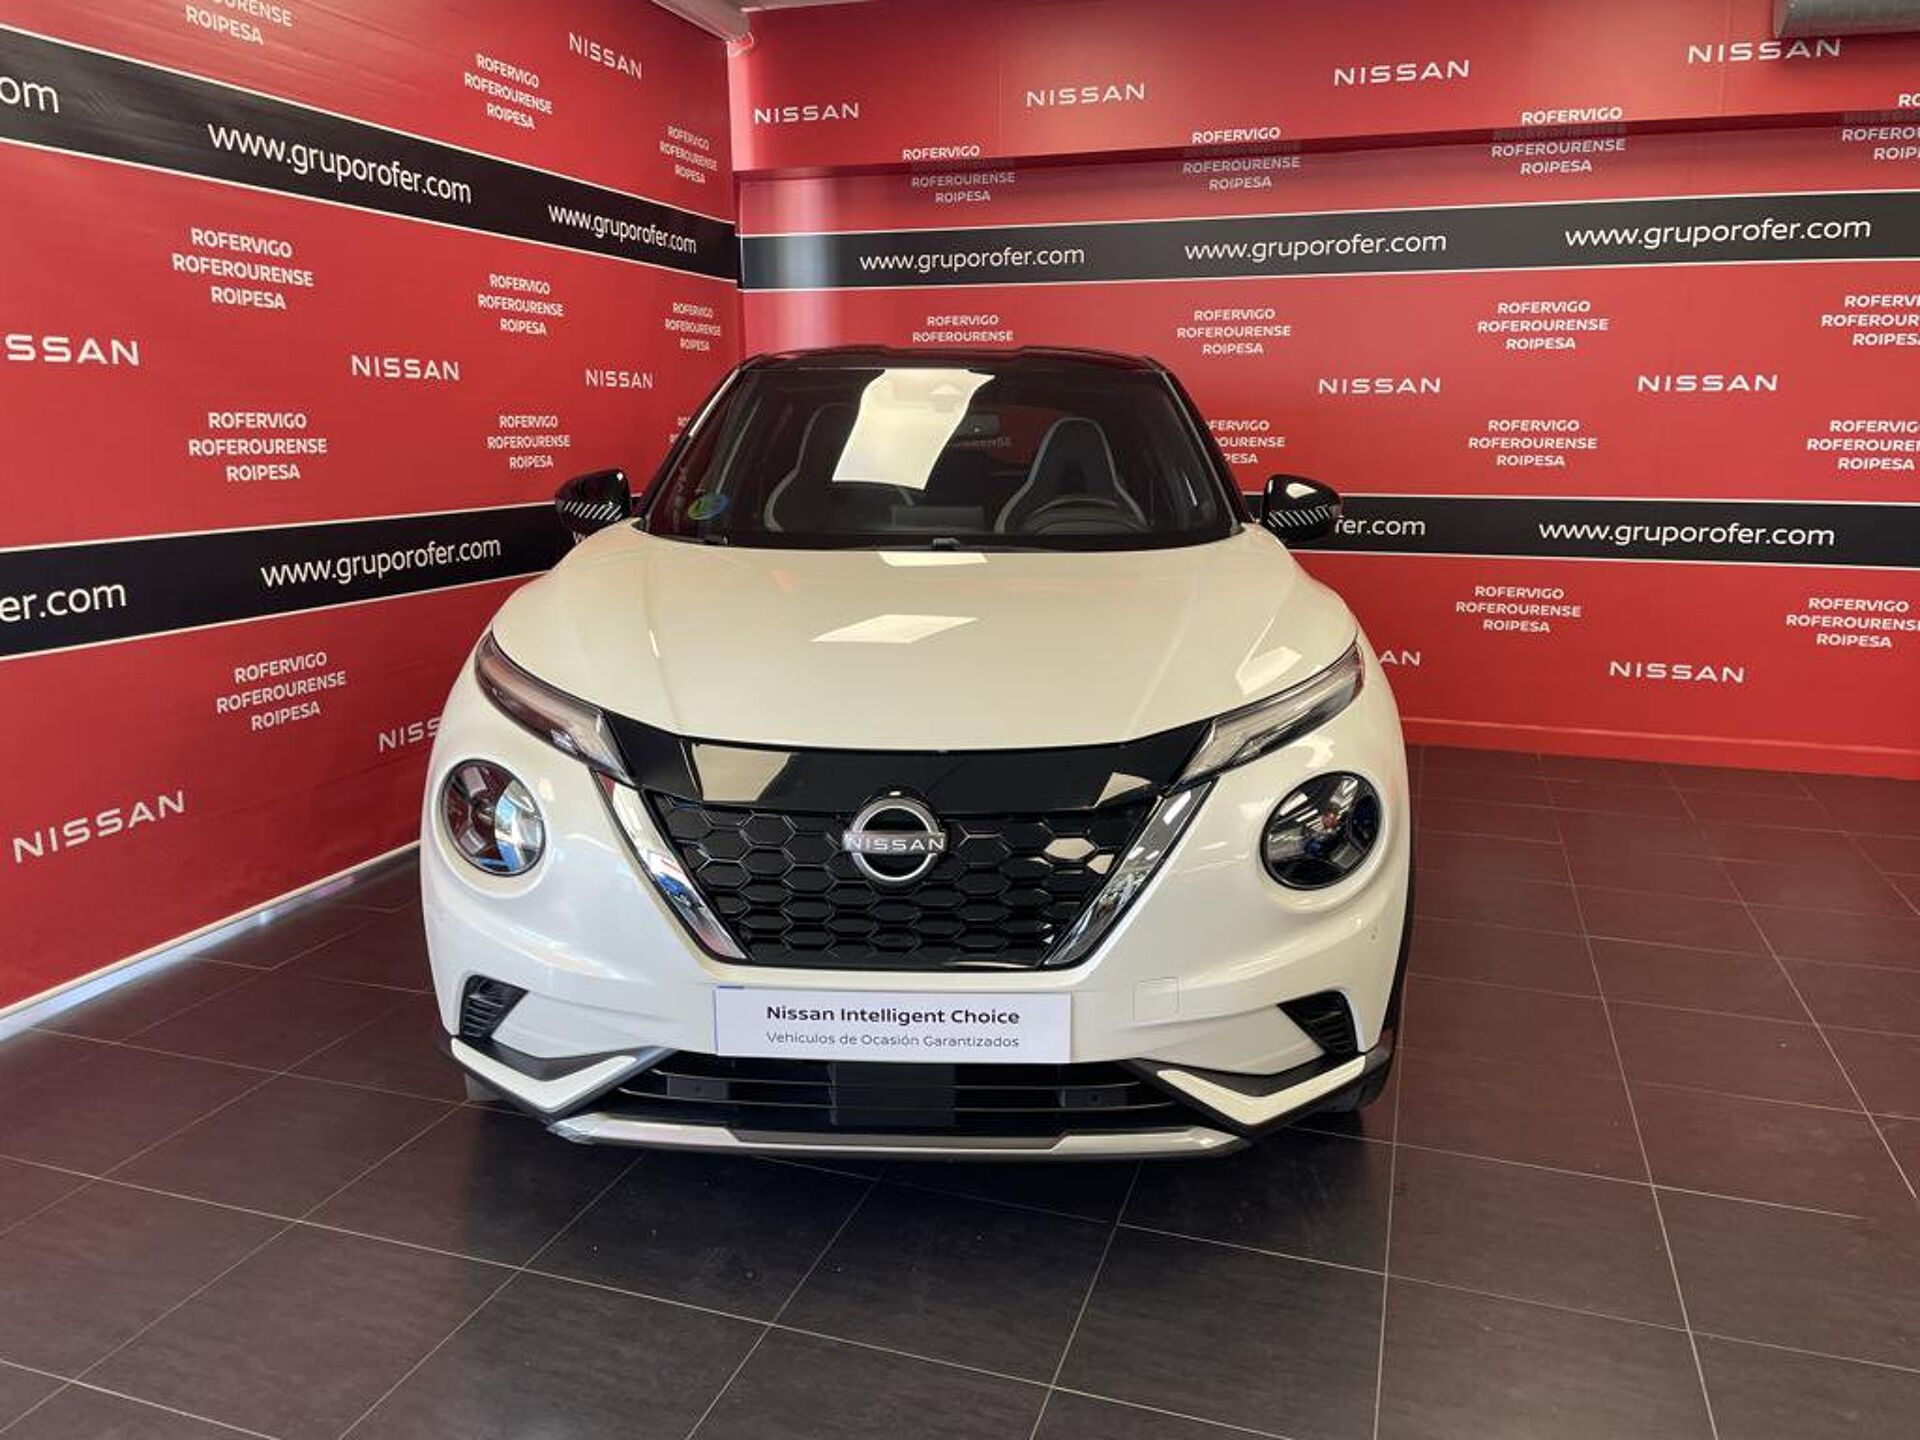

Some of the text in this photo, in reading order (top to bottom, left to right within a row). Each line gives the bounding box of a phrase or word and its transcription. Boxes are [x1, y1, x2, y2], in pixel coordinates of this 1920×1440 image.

[185, 4, 264, 45] ROIPESA
[569, 32, 642, 80] NISSAN
[1687, 39, 1841, 65] NISSAN
[476, 53, 539, 88] ROFERVIGO
[1334, 59, 1470, 86] NISSAN
[465, 73, 552, 114] ROFEROURENSE
[1026, 82, 1145, 108] NISSAN
[487, 104, 535, 129] ROIPESA
[754, 102, 860, 125] NISSAN
[1521, 106, 1623, 126] ROFERVIGO
[1192, 126, 1281, 144] ROFERVIGO
[1842, 127, 1920, 141] ROFERO
[902, 145, 981, 161] ROFERVIGO
[1491, 138, 1627, 158] ROFEROURENSE
[1874, 147, 1920, 160] ROIP
[208, 124, 471, 204] www.gruporofer.com
[1182, 156, 1301, 175] ROFEROURENSE
[1520, 160, 1592, 175] ROIPESA
[911, 171, 1016, 188] ROFEROURENSE
[1208, 175, 1272, 191] ROIPESA
[935, 190, 991, 204] ROIPESA
[549, 204, 697, 254] www.gruporofer.com
[1565, 218, 1871, 250] www.gruporofer.com
[190, 227, 292, 258] ROFERVIGO
[1184, 233, 1447, 262] www.gruporofer.com
[859, 246, 1085, 274] www.gruporofer.com
[172, 253, 314, 287] ROFEROURENSE
[489, 273, 550, 296] ROFERVIGO
[211, 286, 286, 310] ROIPESA
[478, 294, 564, 317] ROFEROURENSE
[1194, 308, 1276, 321] ROFERVIGO
[1497, 300, 1591, 315] ROFERVIGO
[500, 318, 547, 335] ROIPESA
[927, 314, 999, 327] ROFERVIGO
[1477, 318, 1610, 333] ROFEROURENSE
[912, 330, 1014, 343] ROFEROURENSE
[1177, 325, 1291, 339] ROFEROURENSE
[1852, 333, 1920, 346] ROIPES
[1202, 342, 1264, 355] ROIPESA
[1505, 337, 1576, 350] ROIPESA
[352, 354, 460, 381] NISSAN
[586, 369, 653, 389] NISSAN
[1319, 377, 1441, 394] NISSAN
[1637, 374, 1778, 392] NISSAN
[208, 411, 307, 429] ROFERVIGO
[499, 414, 558, 429] ROFERVIGO
[1207, 419, 1271, 431] FERVIGO
[1488, 419, 1580, 432] ROFERVIGO
[1830, 419, 1920, 433] ROFERVIG
[188, 438, 327, 456] ROFEROURENSE
[487, 435, 570, 449] ROFEROURENSE
[1216, 436, 1286, 447] OURENSE
[1468, 437, 1597, 450] ROFEROURENSE
[509, 455, 553, 470] ROIPESA
[1496, 454, 1566, 467] ROIPESA
[1838, 457, 1916, 471] ROIPESA
[226, 464, 301, 482] ROIPESA
[1539, 522, 1835, 546] www.gruporofer.com
[261, 538, 501, 588] www.gruporofer.com
[1474, 585, 1565, 600] ROFERVIGO
[1455, 601, 1582, 618] ROFEROURENSE
[1808, 598, 1910, 612] ROFERVIGO
[1482, 619, 1551, 633] ROIPESA
[1816, 633, 1892, 648] ROIPESA
[234, 651, 328, 684] ROFERVIGO
[1609, 660, 1745, 684] NISSAN
[217, 670, 346, 714] ROFEROURENSE
[251, 701, 320, 731] ROIPESA
[378, 717, 440, 753] NISS
[12, 789, 185, 864] NISSAN
[850, 838, 944, 851] NISSAN
[767, 1006, 1020, 1026] Nissan Intelligent Choice
[839, 1033, 858, 1045] de
[860, 1033, 919, 1046] Ocasión
[923, 1035, 1020, 1048] Garantizados
